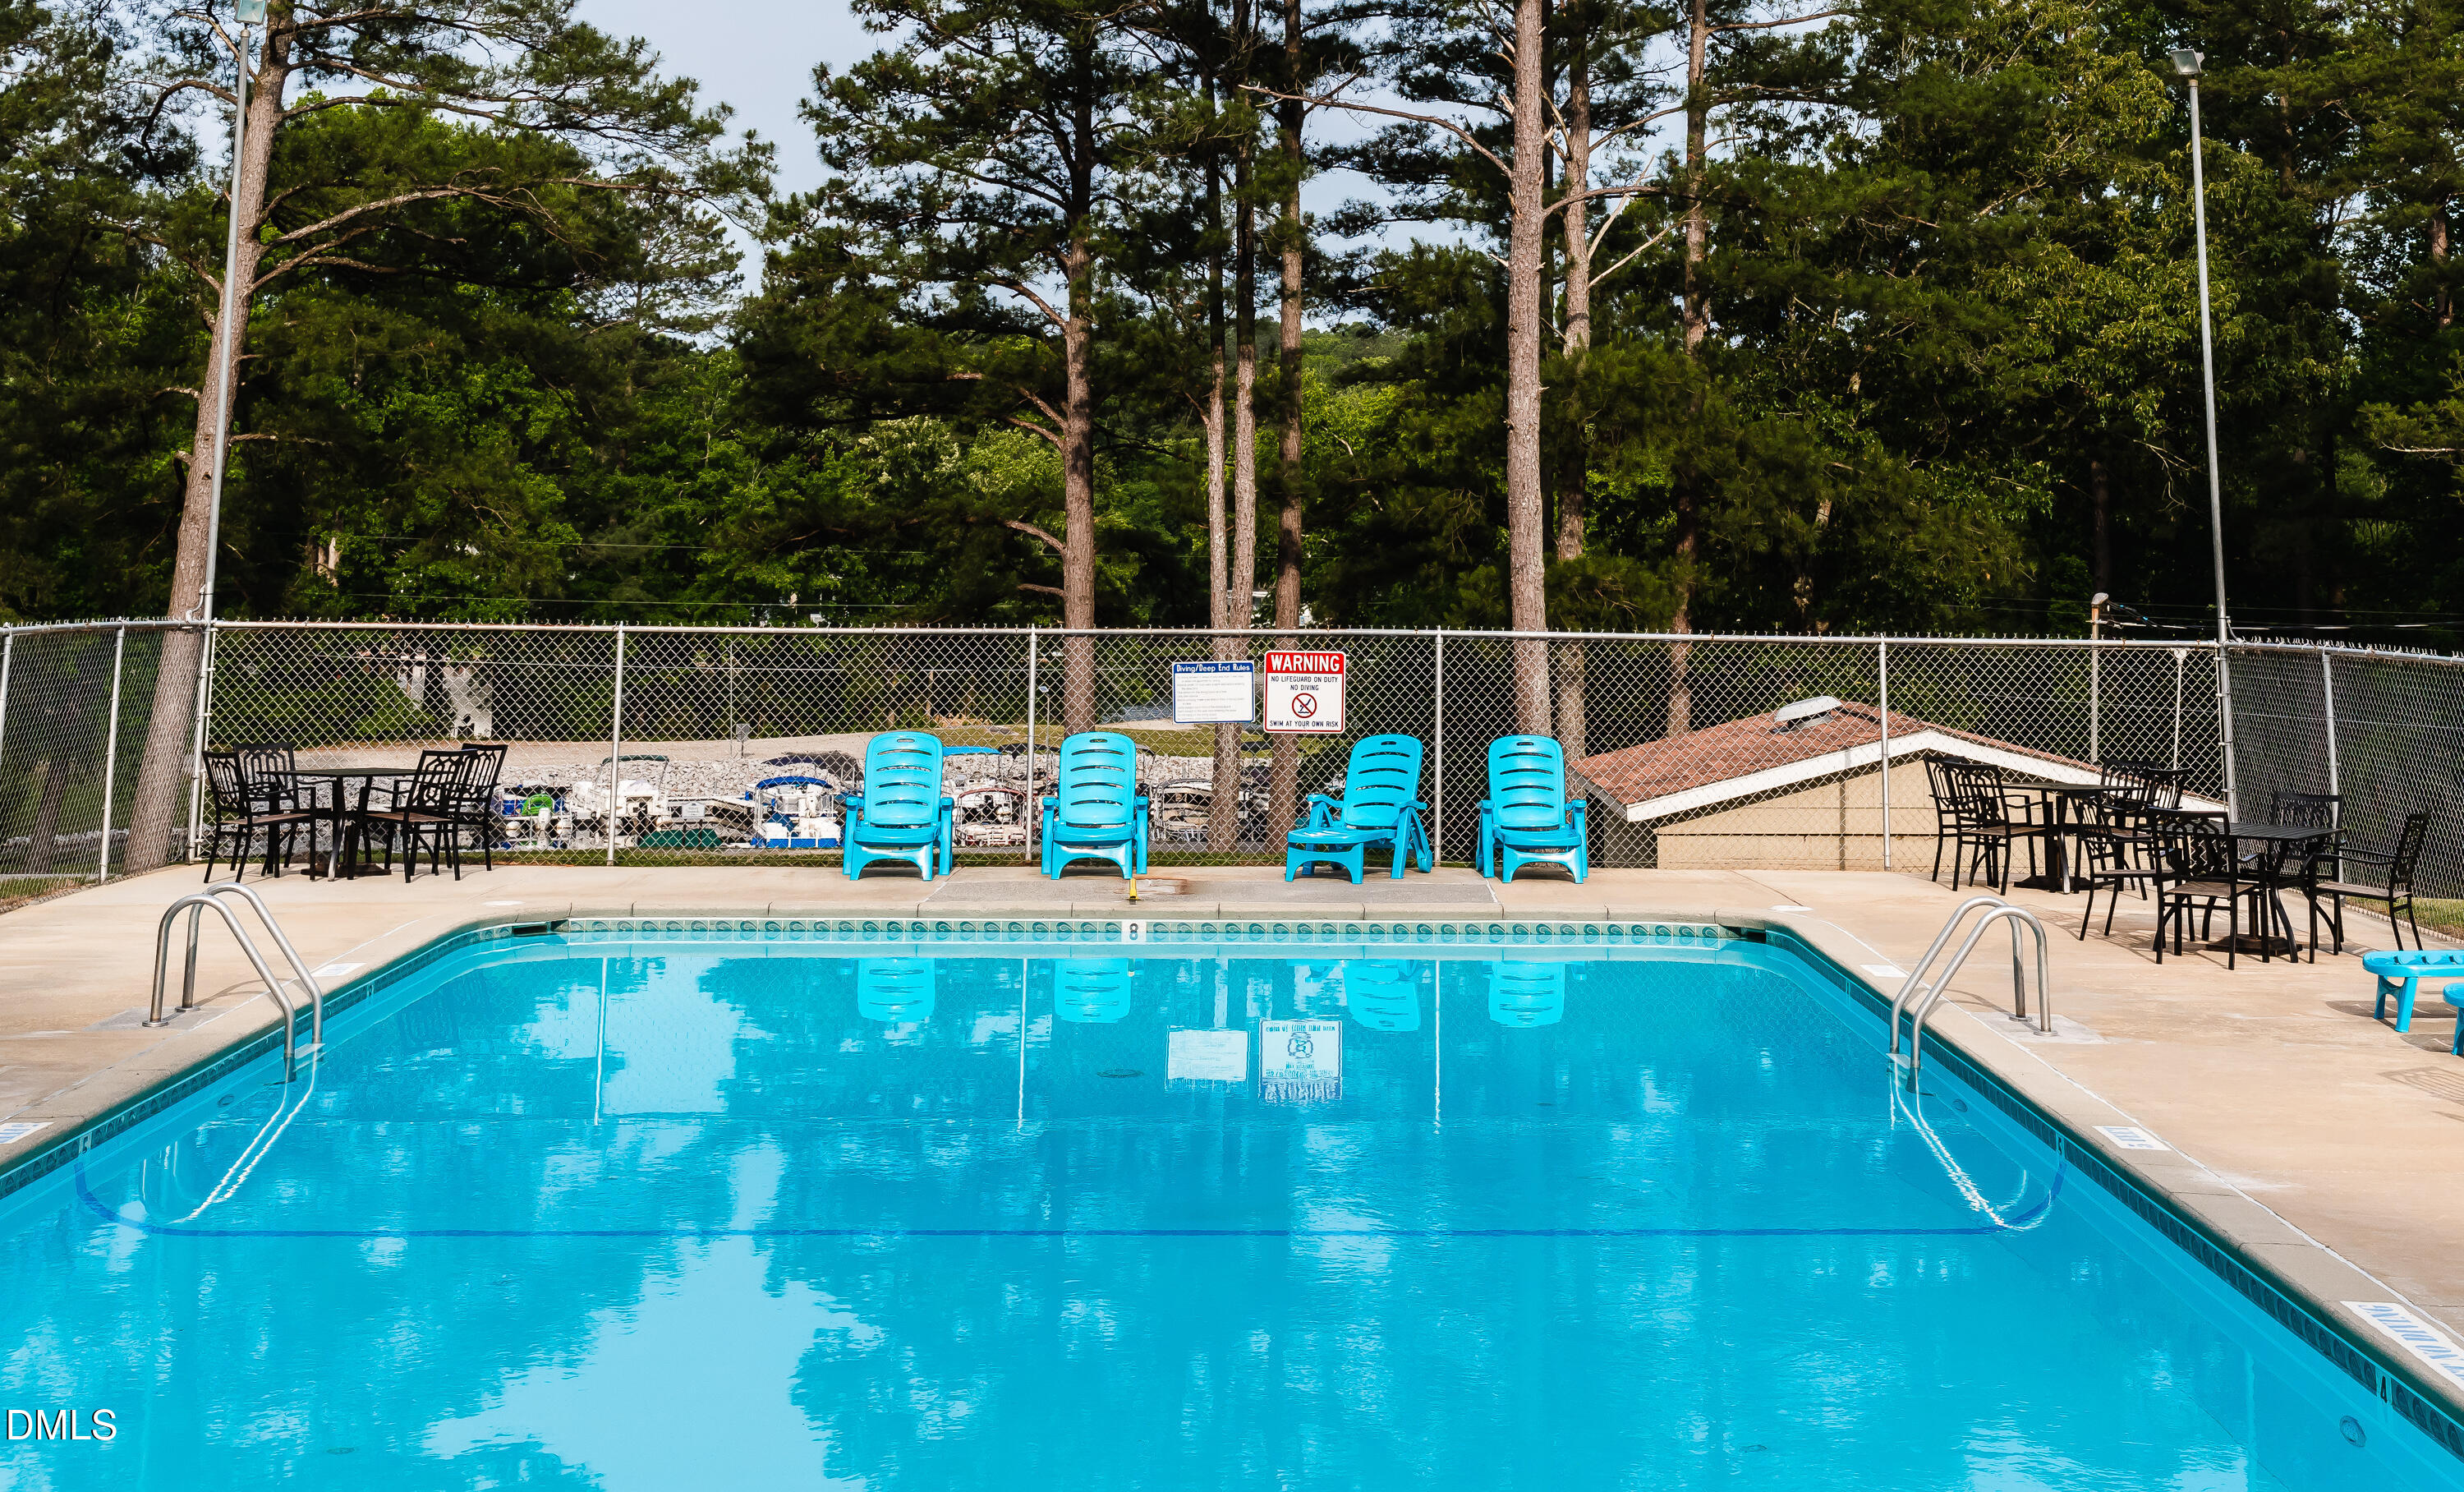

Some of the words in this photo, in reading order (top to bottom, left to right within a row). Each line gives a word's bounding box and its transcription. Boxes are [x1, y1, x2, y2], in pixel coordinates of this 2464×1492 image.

[1176, 664, 1216, 673] Diving/Deep
[1218, 663, 1230, 672] End
[1233, 663, 1250, 671] Rules
[1271, 655, 1340, 672] WARNING
[2358, 1305, 2439, 1342] DIVING
